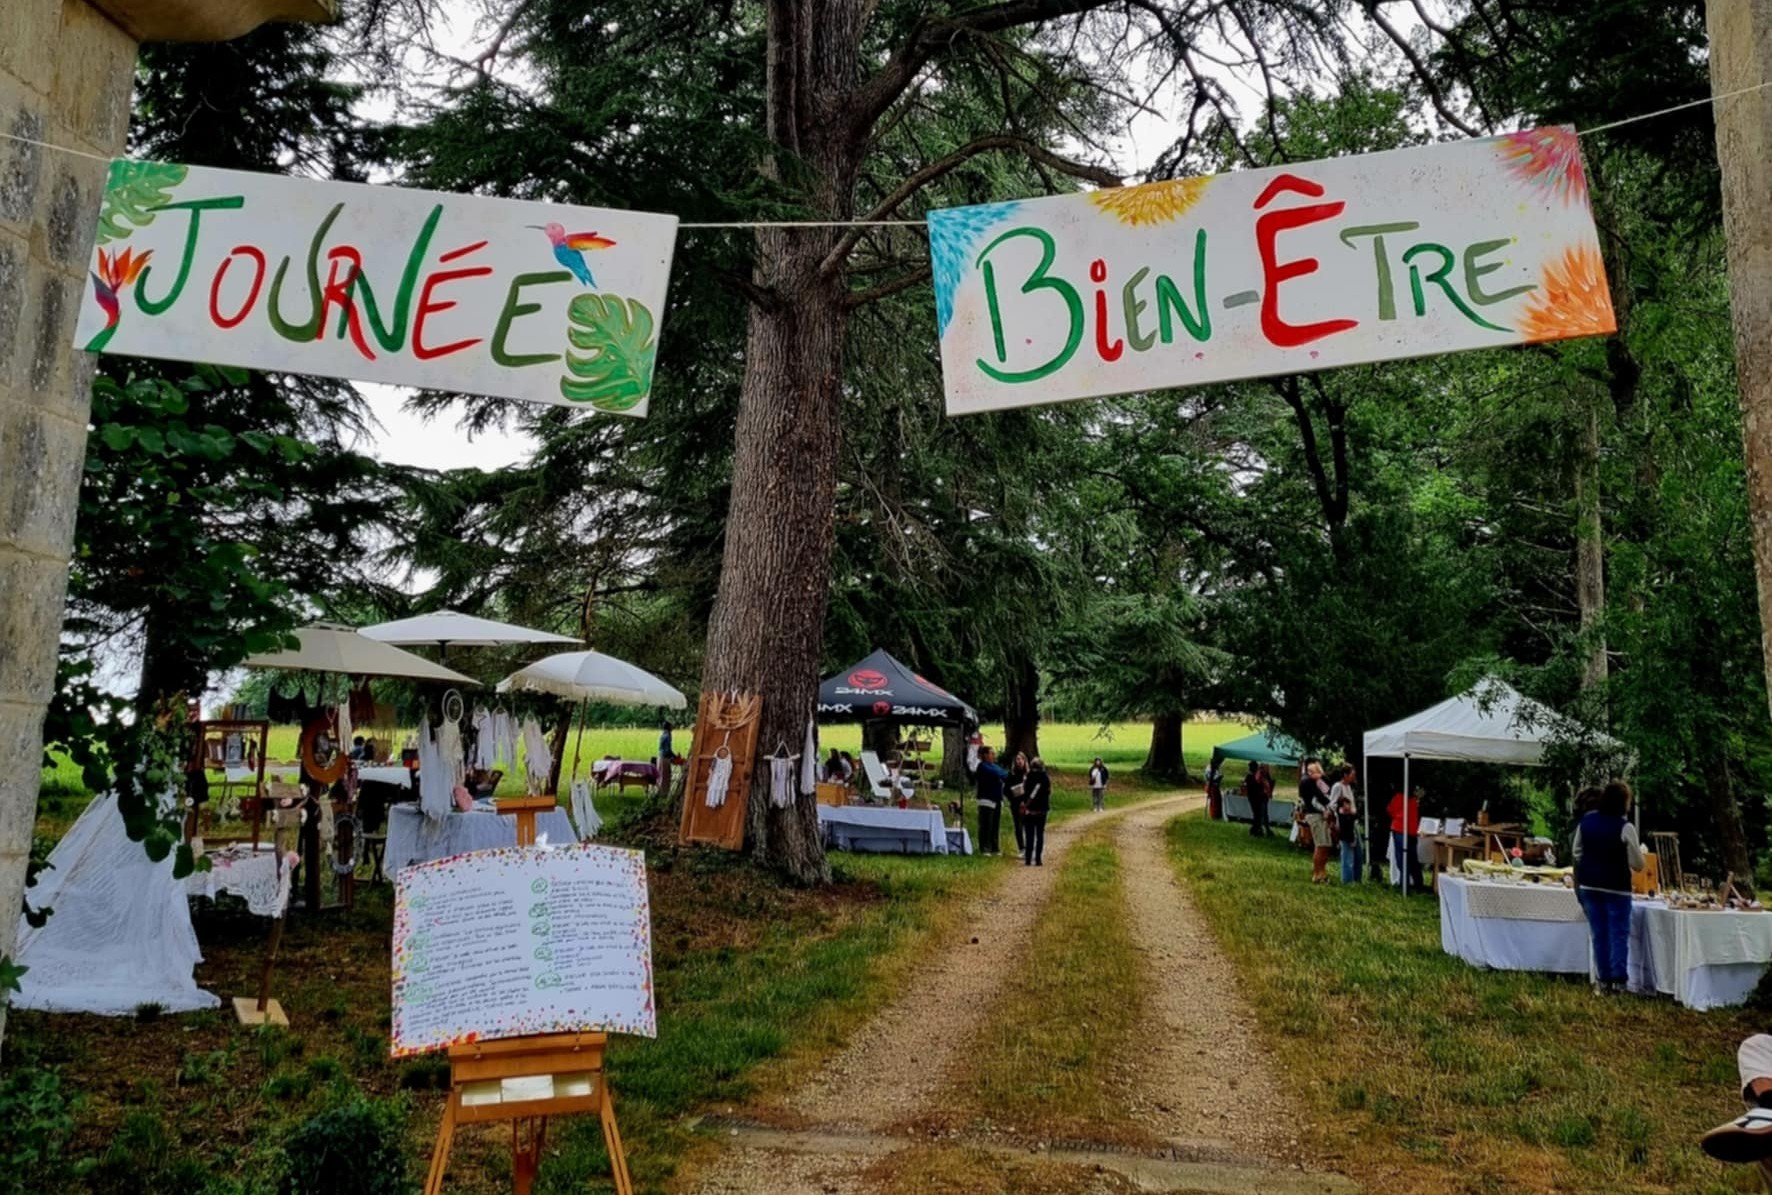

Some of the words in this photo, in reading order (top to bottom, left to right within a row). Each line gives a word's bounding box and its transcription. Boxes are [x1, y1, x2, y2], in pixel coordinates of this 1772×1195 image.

[133, 196, 573, 367] JOURNÉE
[834, 686, 895, 697] 24MX
[891, 705, 948, 718] 24MX
